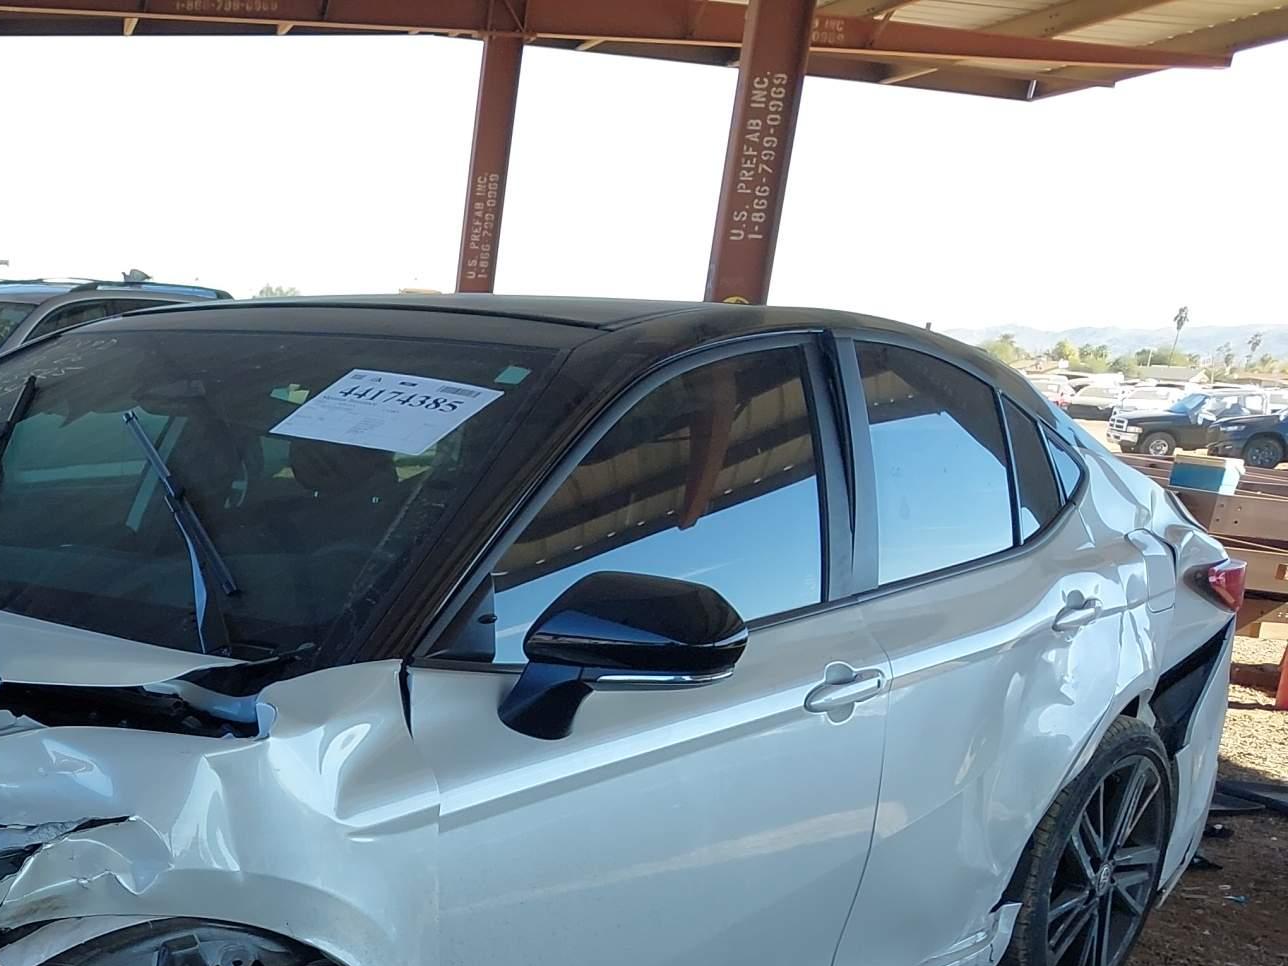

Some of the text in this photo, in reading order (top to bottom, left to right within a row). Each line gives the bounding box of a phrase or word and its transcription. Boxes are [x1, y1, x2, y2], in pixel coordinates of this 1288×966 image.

[729, 71, 771, 241] U.S. PREFAB INC.
[748, 73, 788, 240] 1-866-799-0969
[470, 202, 485, 250] PREFAB
[466, 254, 479, 280] U.S.
[339, 384, 465, 413] 44174385
